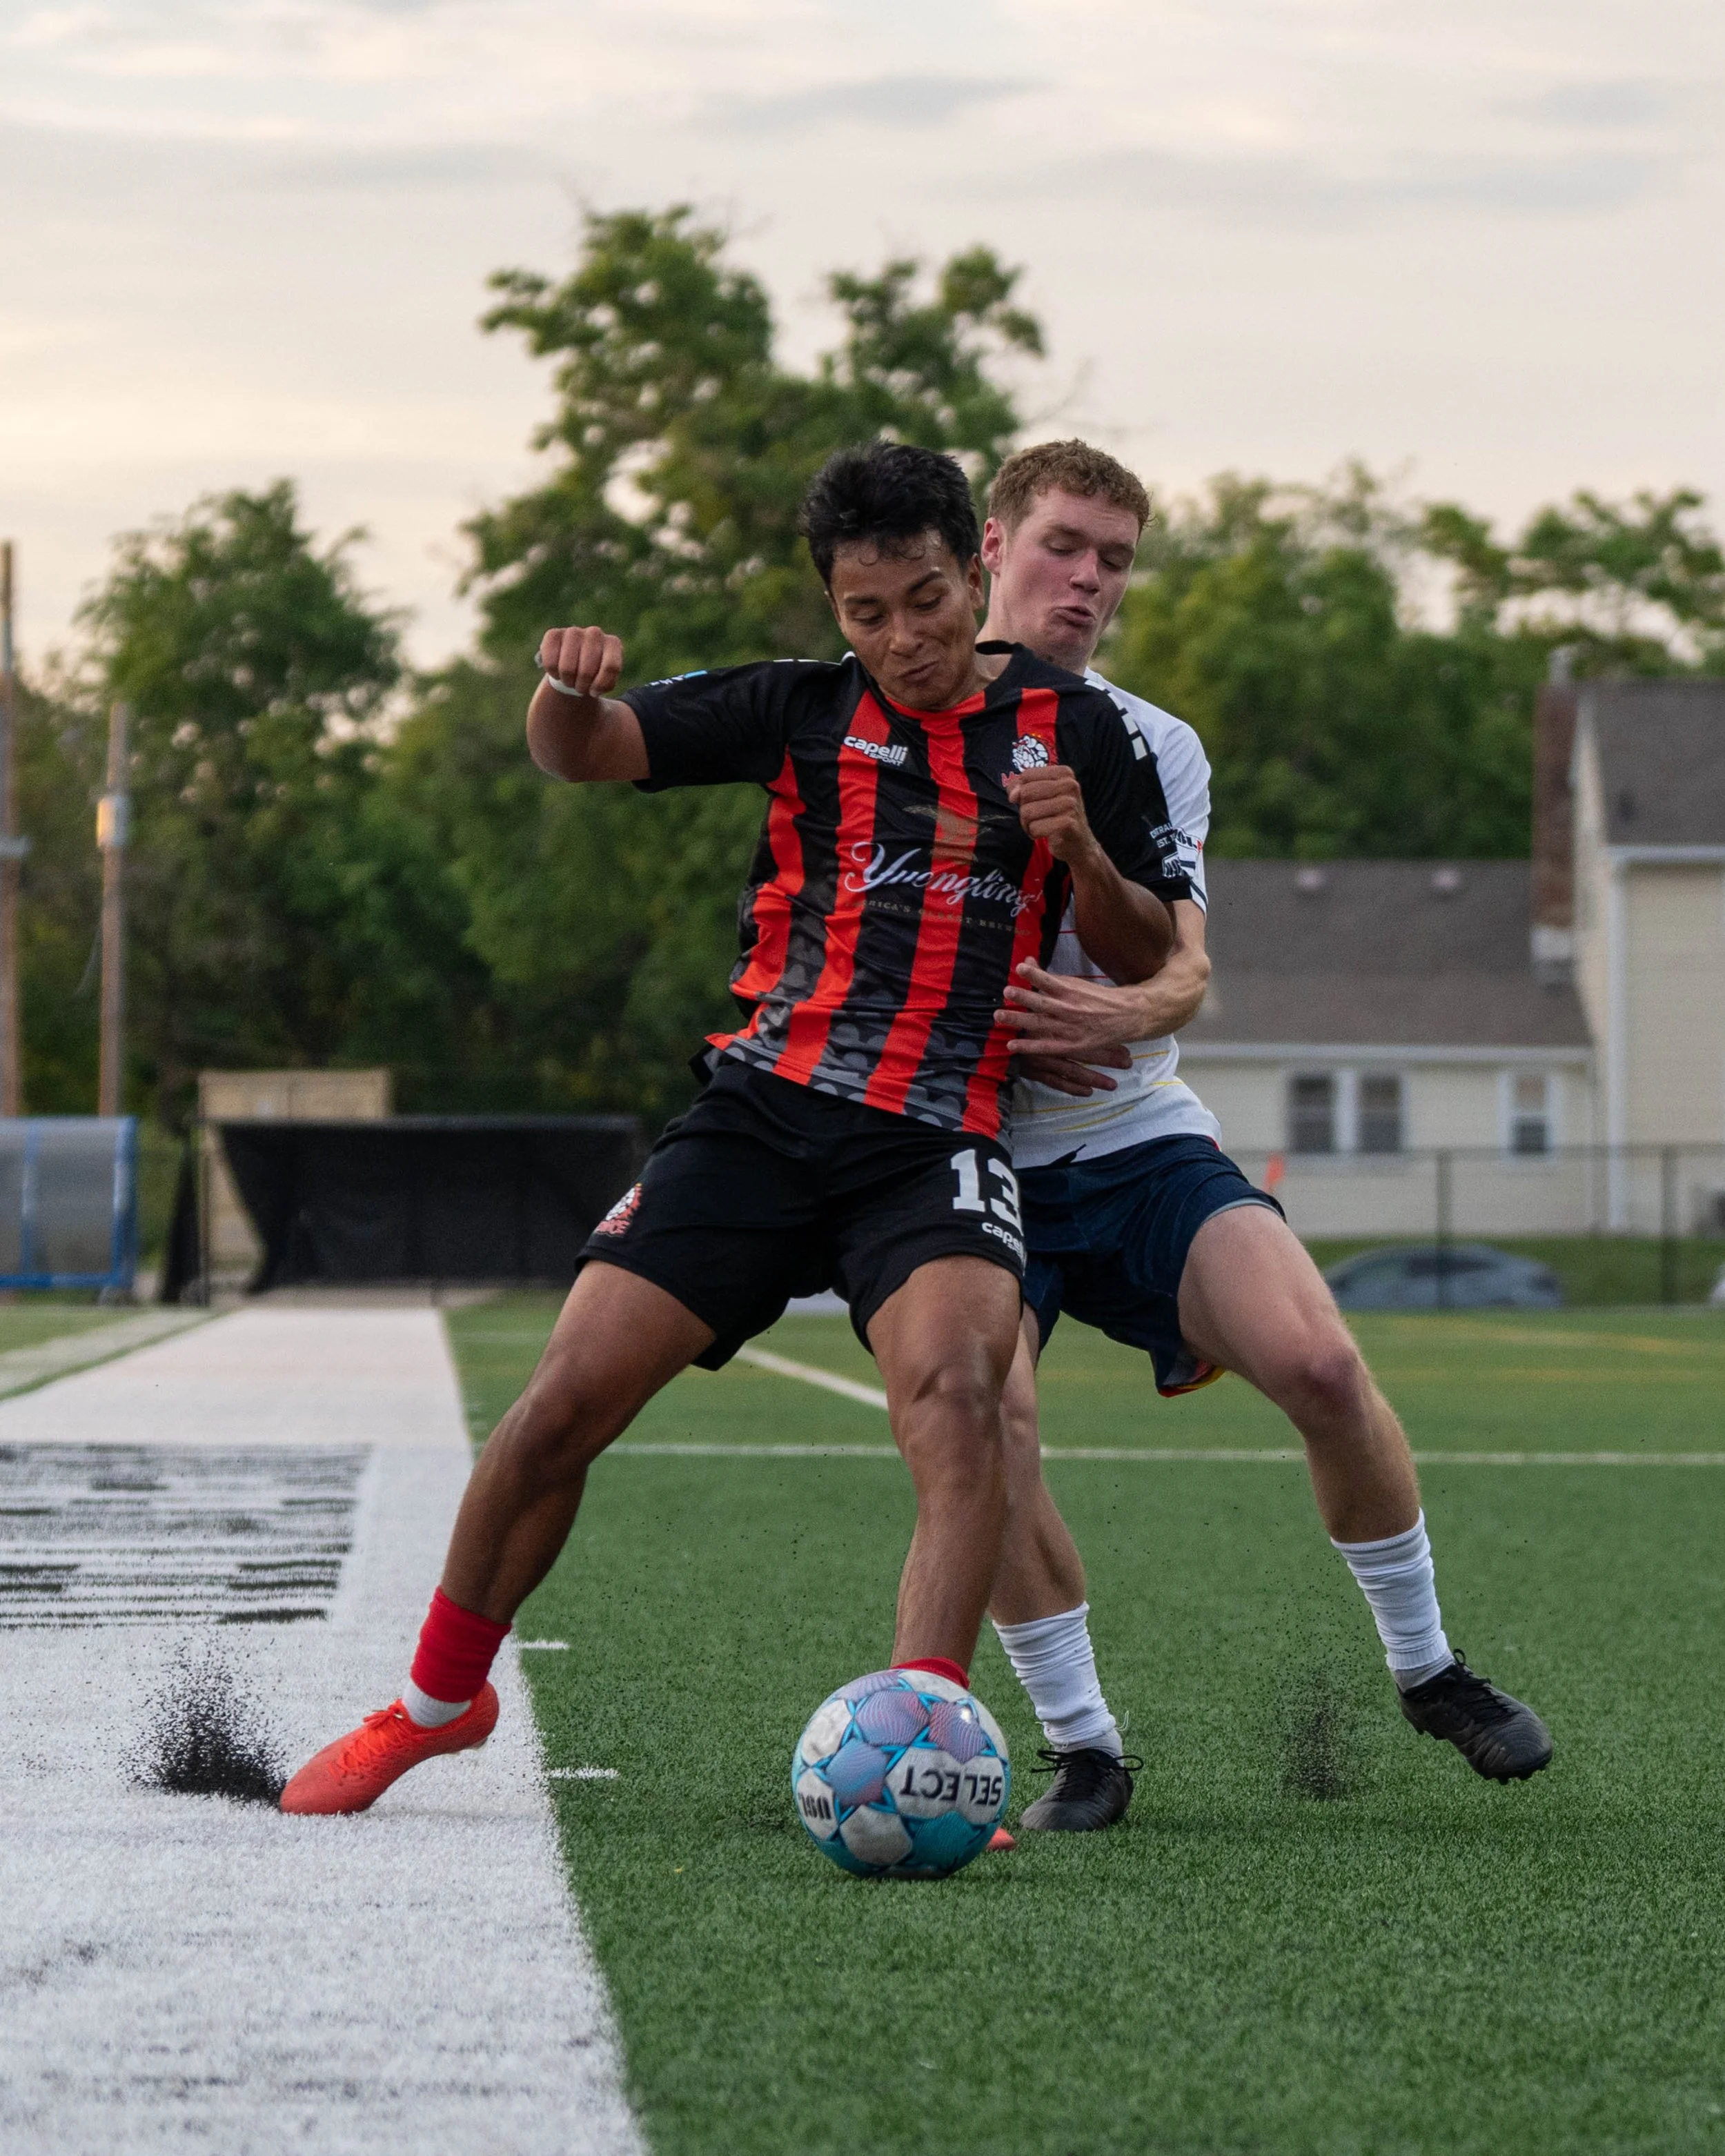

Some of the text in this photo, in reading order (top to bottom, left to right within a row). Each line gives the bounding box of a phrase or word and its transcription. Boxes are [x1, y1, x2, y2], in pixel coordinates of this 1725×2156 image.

[843, 735, 907, 762] capelli
[844, 841, 1043, 918] Yuengling
[950, 1149, 1025, 1237] 13
[898, 1766, 1002, 1806] SELECT
[797, 1792, 832, 1821] USL
